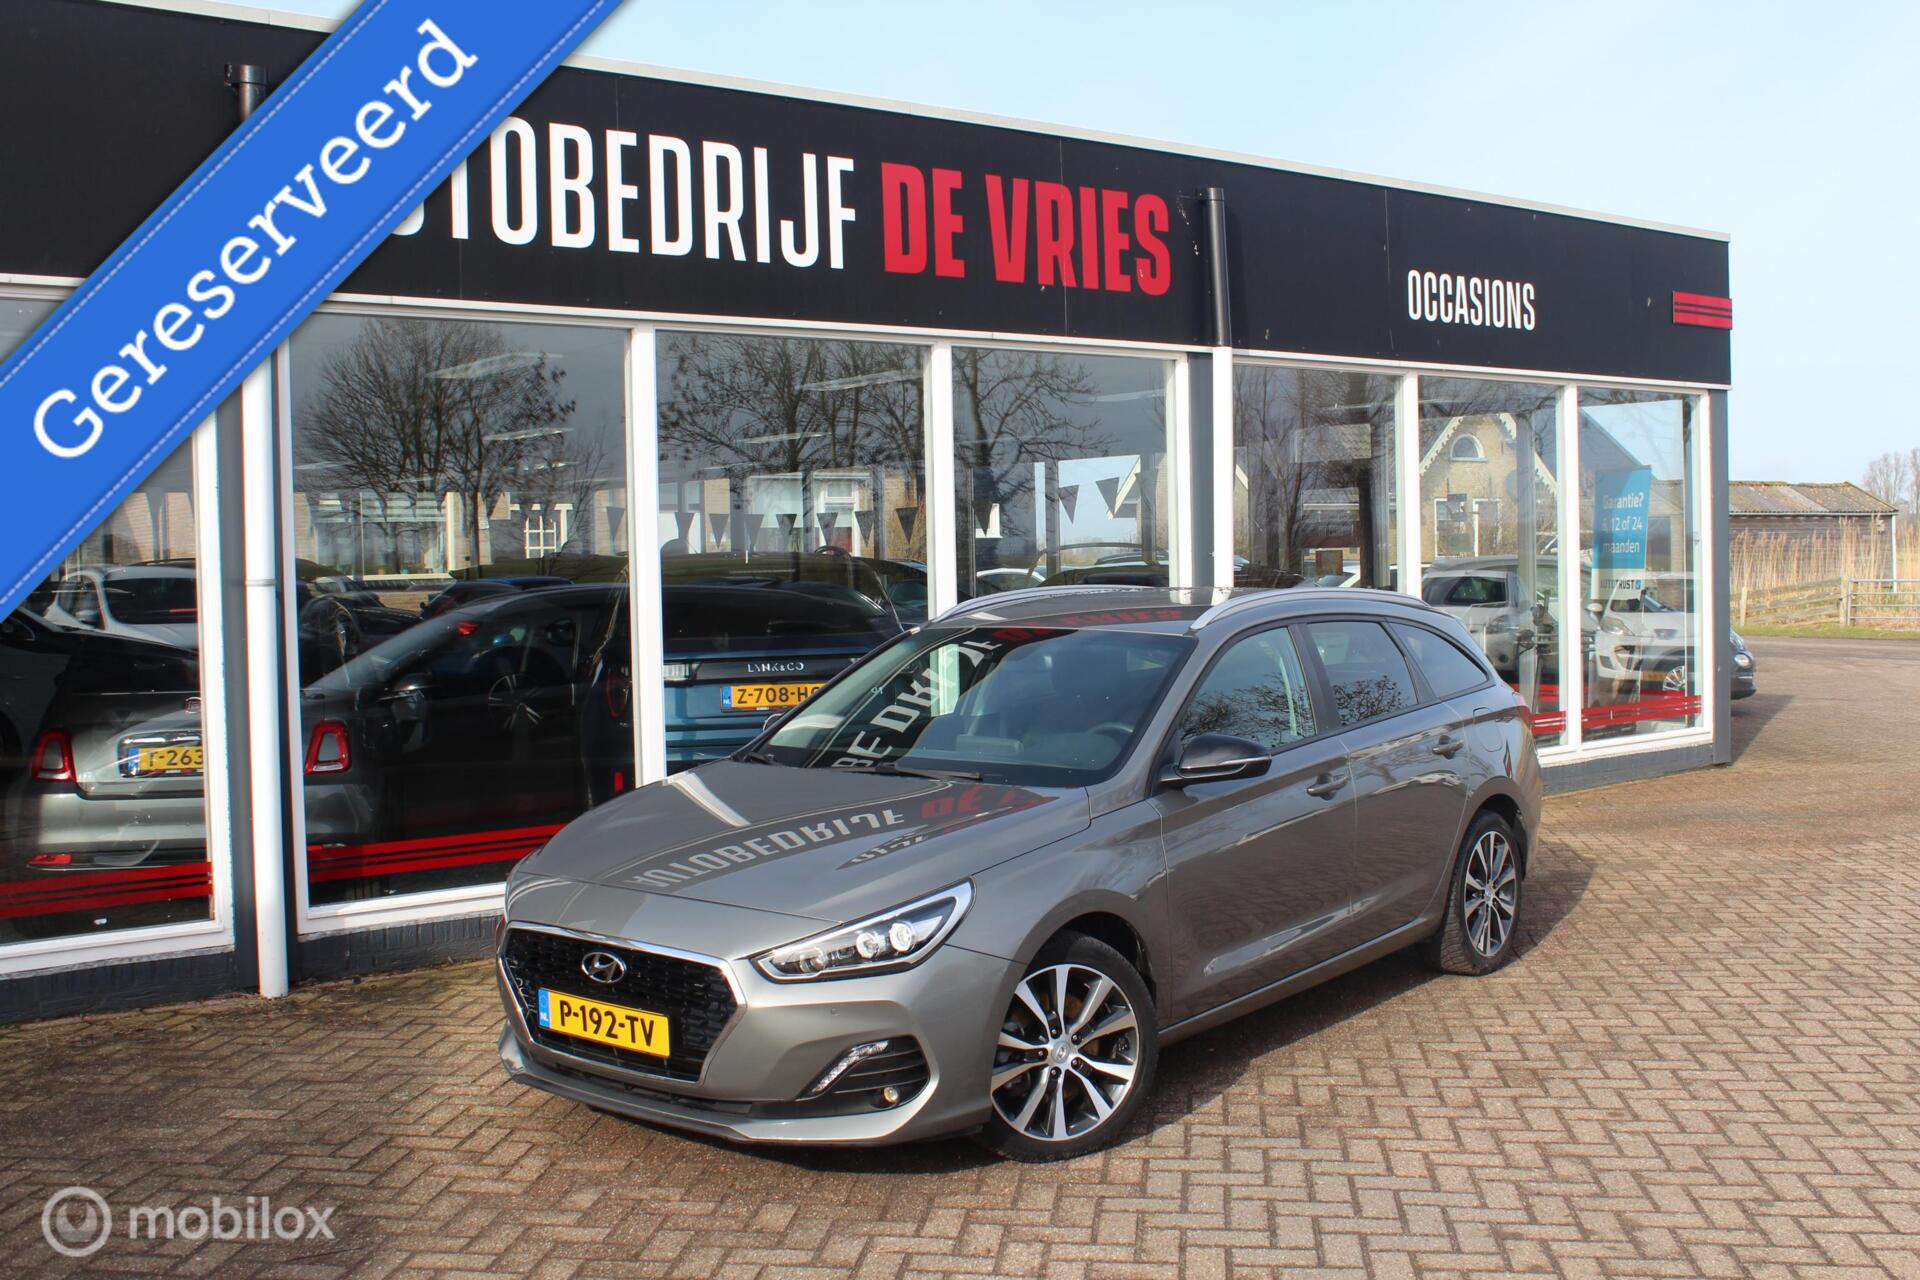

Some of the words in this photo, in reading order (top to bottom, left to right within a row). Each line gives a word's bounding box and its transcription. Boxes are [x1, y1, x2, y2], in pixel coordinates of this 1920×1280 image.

[881, 162, 965, 278] DE
[984, 174, 1172, 296] VRIES
[1407, 269, 1535, 331] OCCASIONS
[1603, 538, 1640, 553] maanden
[1632, 516, 1643, 530] 24
[559, 1000, 655, 1047] P-192-TV
